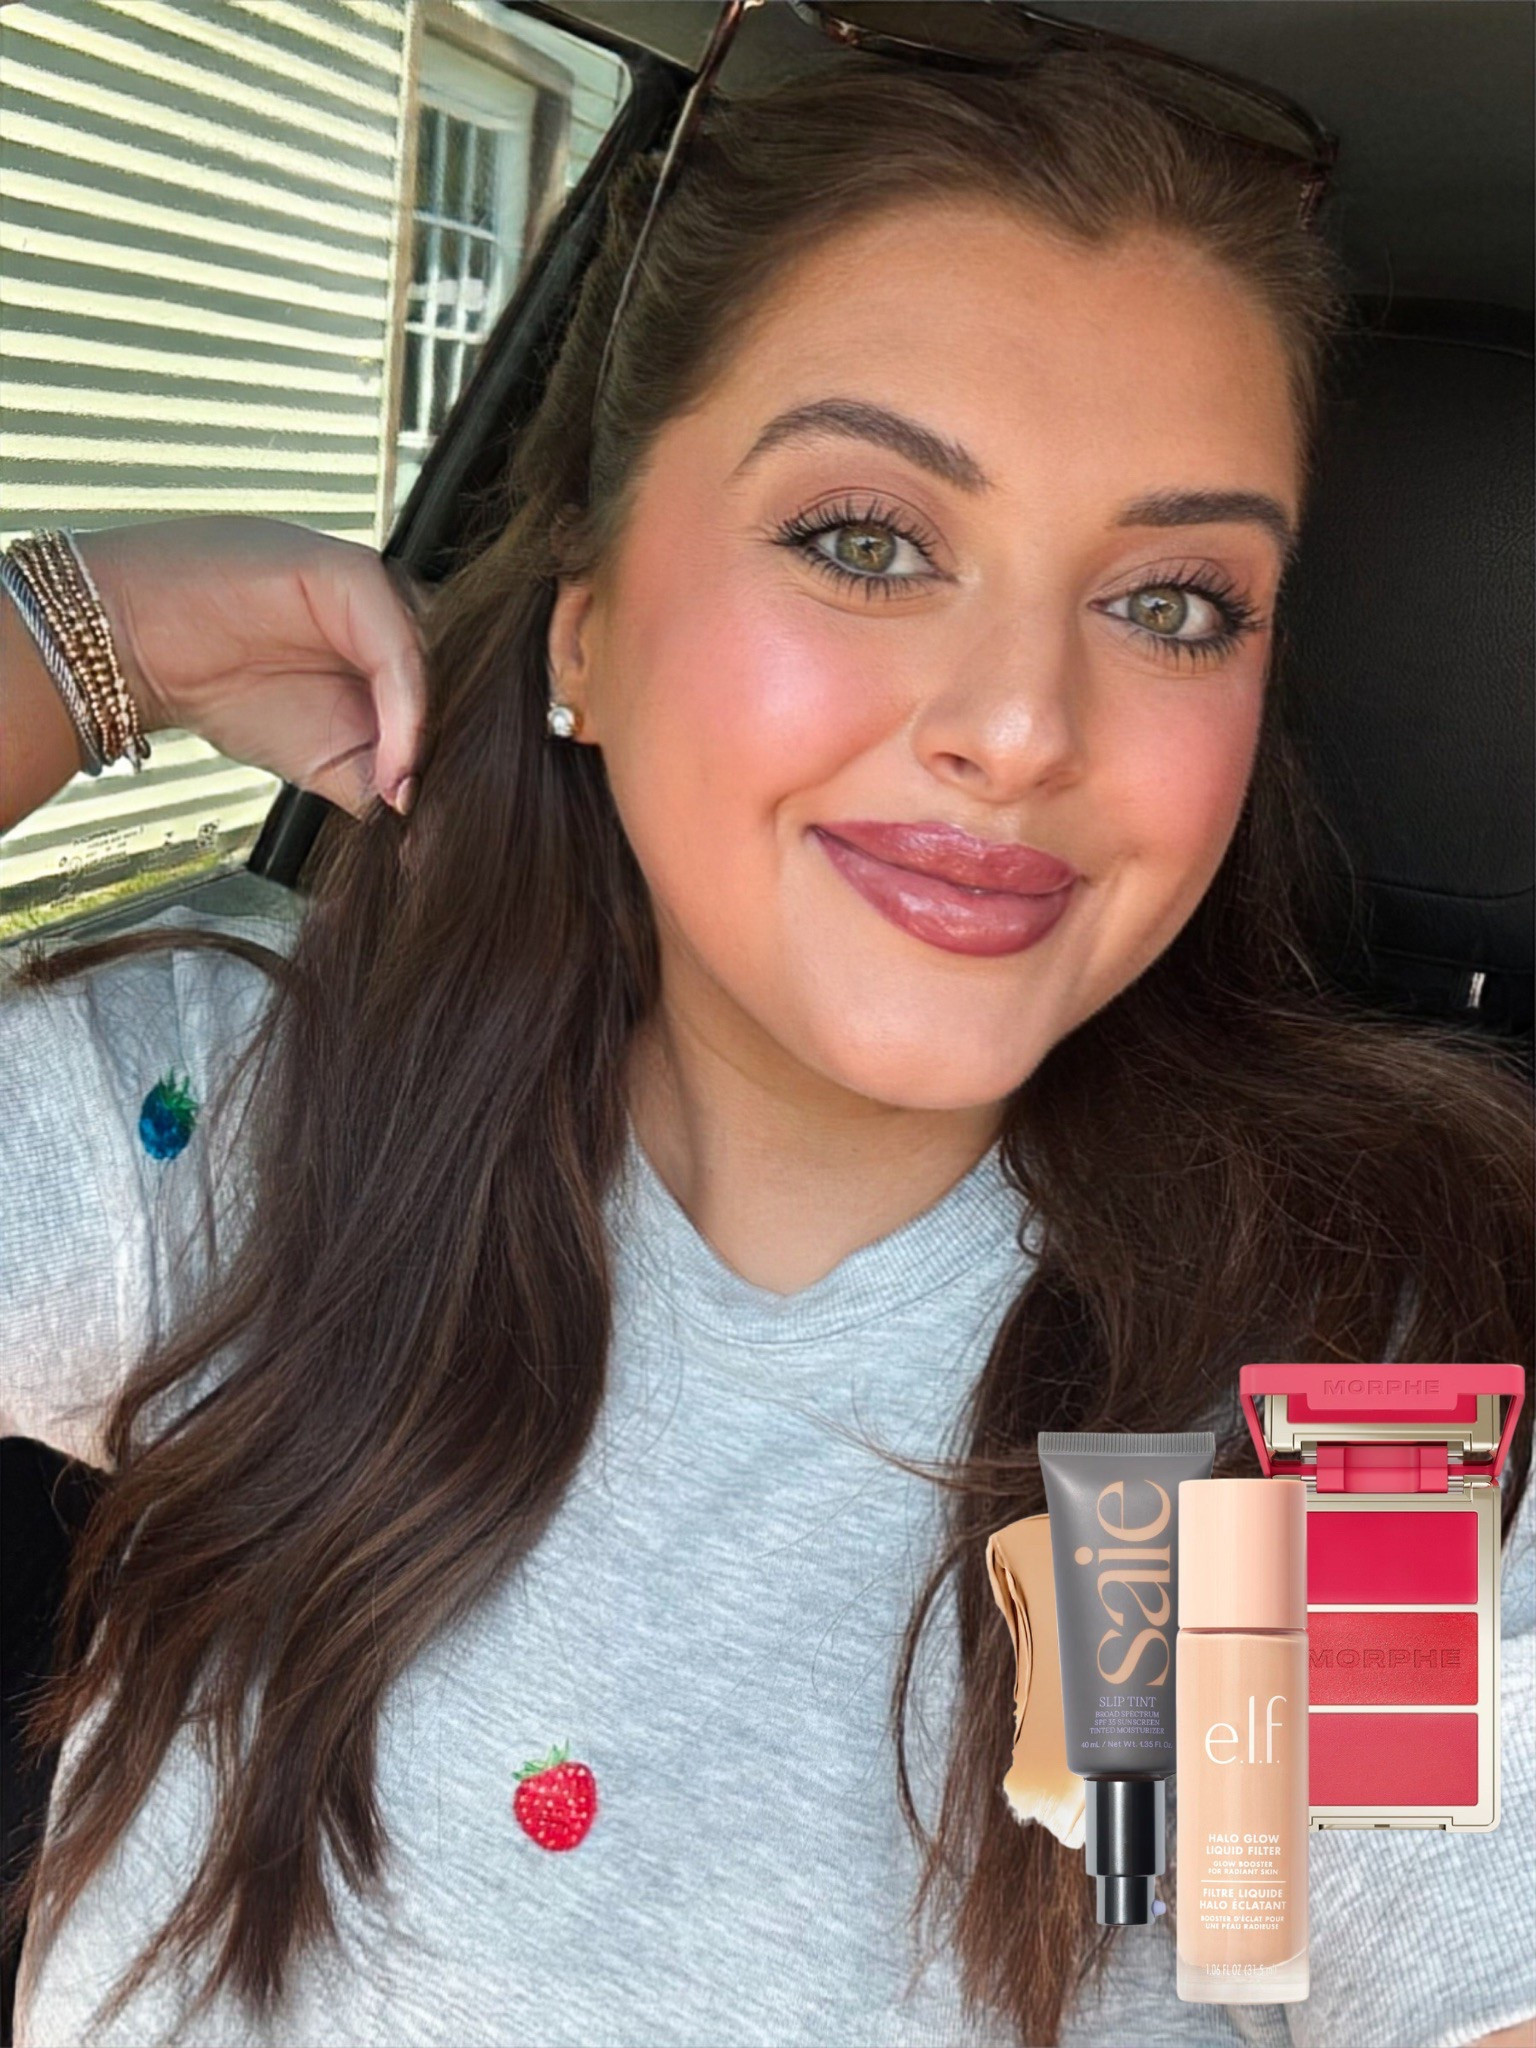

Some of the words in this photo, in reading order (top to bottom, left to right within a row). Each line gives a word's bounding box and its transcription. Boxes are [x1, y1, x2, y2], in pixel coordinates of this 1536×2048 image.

[1323, 1379, 1440, 1395] MORPHE
[1074, 1479, 1171, 1686] saie
[1308, 1649, 1462, 1668] MORPHE
[1099, 1696, 1125, 1708] SLIP
[1127, 1696, 1156, 1708] TINT
[1107, 1740, 1121, 1748] Net
[1208, 1834, 1239, 1843] HALO
[1243, 1834, 1280, 1843] GLOW
[1206, 1846, 1243, 1855] LIQUID
[1247, 1846, 1281, 1855] FILTER
[1203, 1888, 1234, 1898] FILTRE
[1239, 1888, 1283, 1898] LIQUIDE
[1200, 1901, 1228, 1910] HALO
[1231, 1898, 1287, 1910] ÉCLATANT
[1231, 1963, 1242, 1976] OZ
